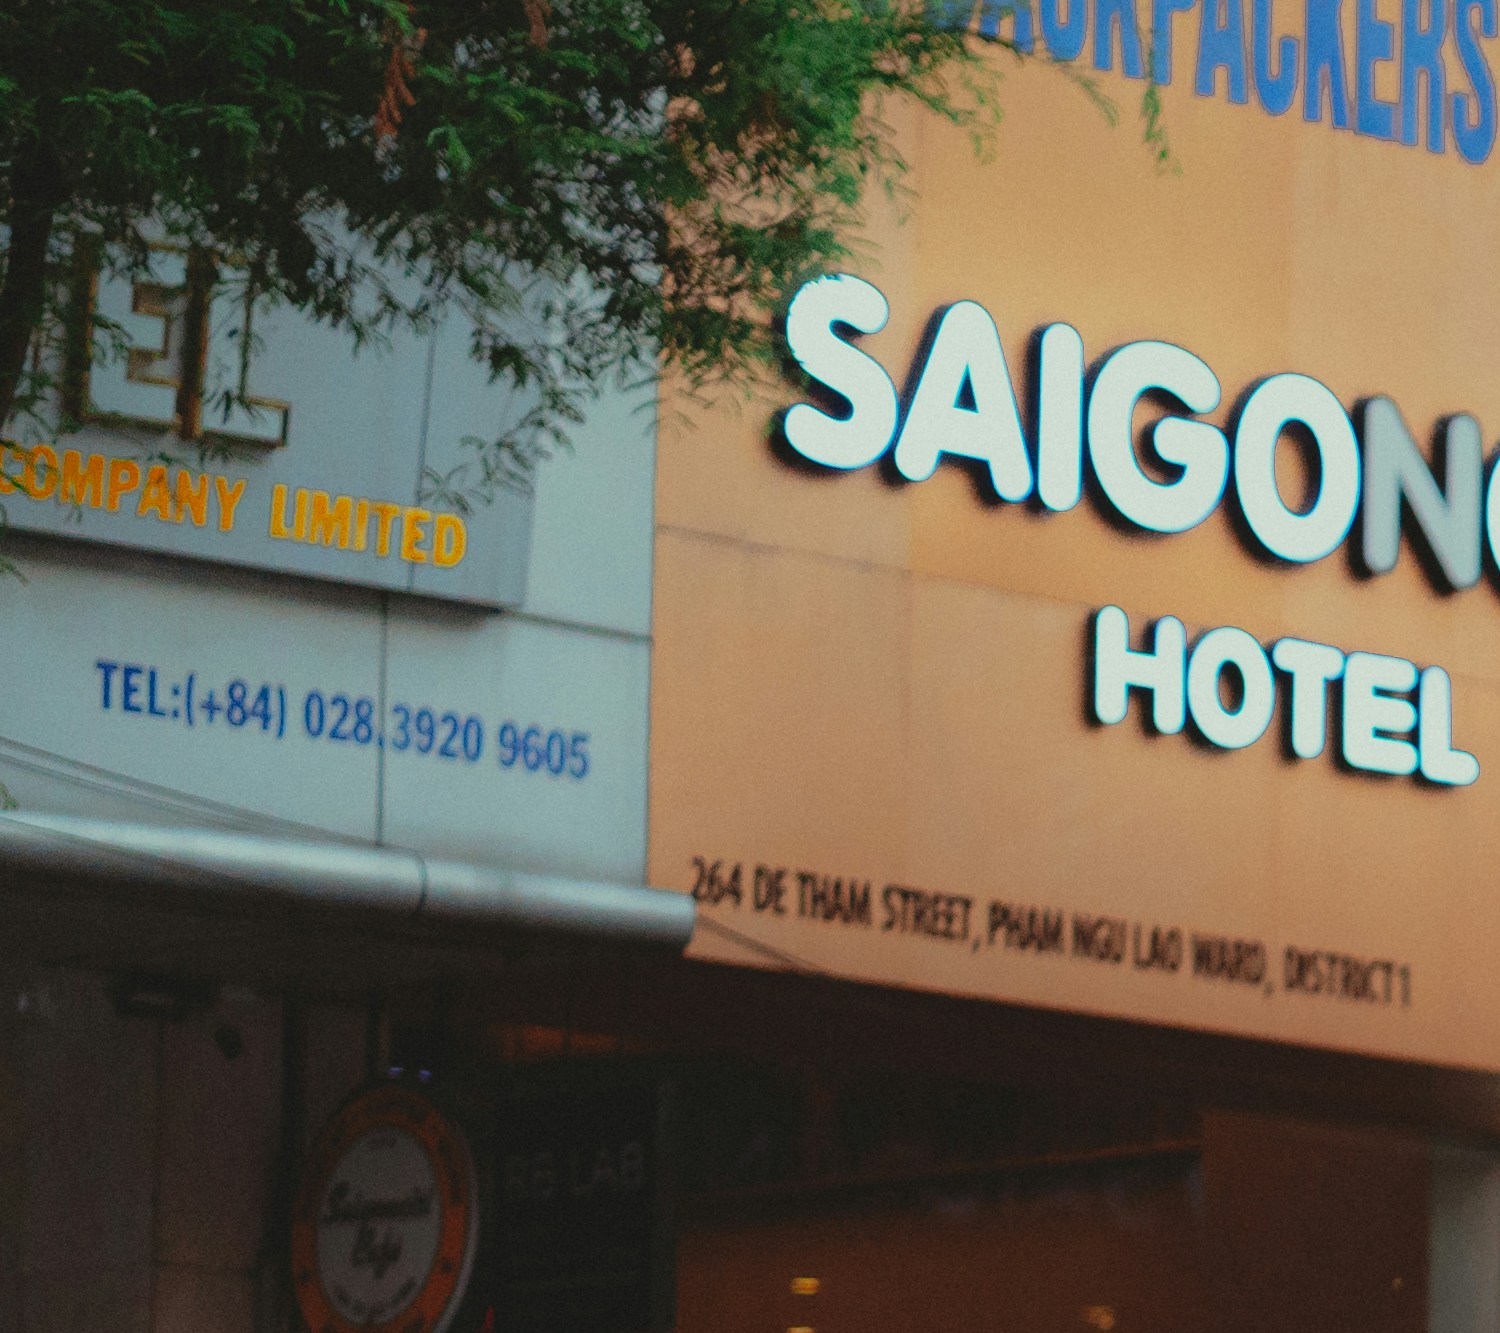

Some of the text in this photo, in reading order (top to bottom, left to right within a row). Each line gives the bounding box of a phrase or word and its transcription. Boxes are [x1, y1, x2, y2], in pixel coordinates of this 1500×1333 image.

[0, 438, 468, 568] COMPANY LIMITED
[497, 721, 593, 782] 9605
[1093, 604, 1482, 787] HOTEL
[691, 856, 743, 911] 264
[752, 864, 786, 916] DE
[796, 868, 872, 928] THAM
[987, 901, 1064, 958] PHAM
[1071, 911, 1128, 967] NGU
[1131, 920, 1183, 976] LAO
